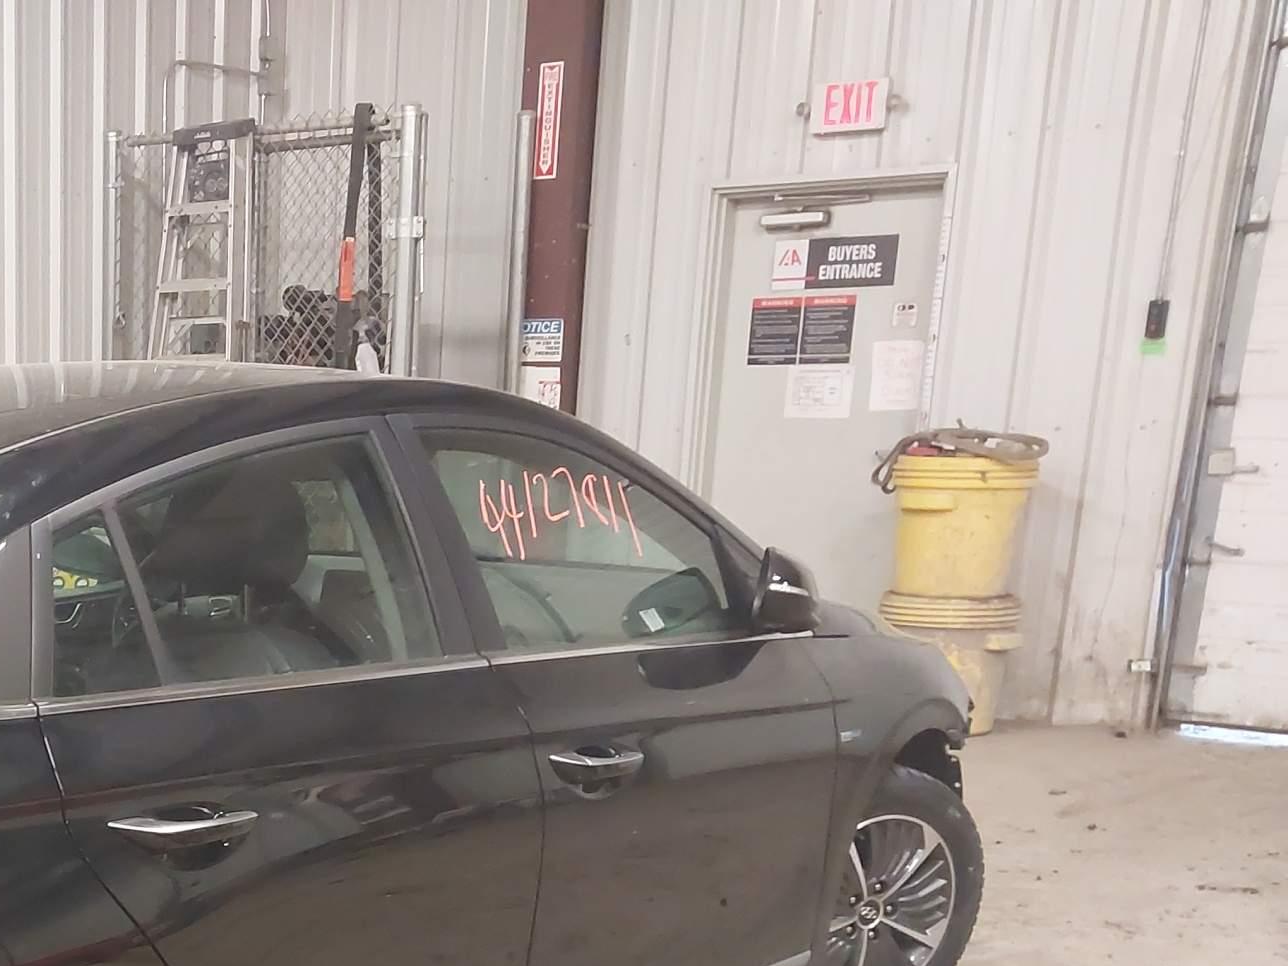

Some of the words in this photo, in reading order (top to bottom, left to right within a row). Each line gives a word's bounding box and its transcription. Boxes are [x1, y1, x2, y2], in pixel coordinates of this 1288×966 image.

[824, 81, 879, 126] EXIT
[828, 243, 877, 261] BUYERS
[818, 262, 883, 280] ENTRANCE
[522, 320, 560, 334] OTICE
